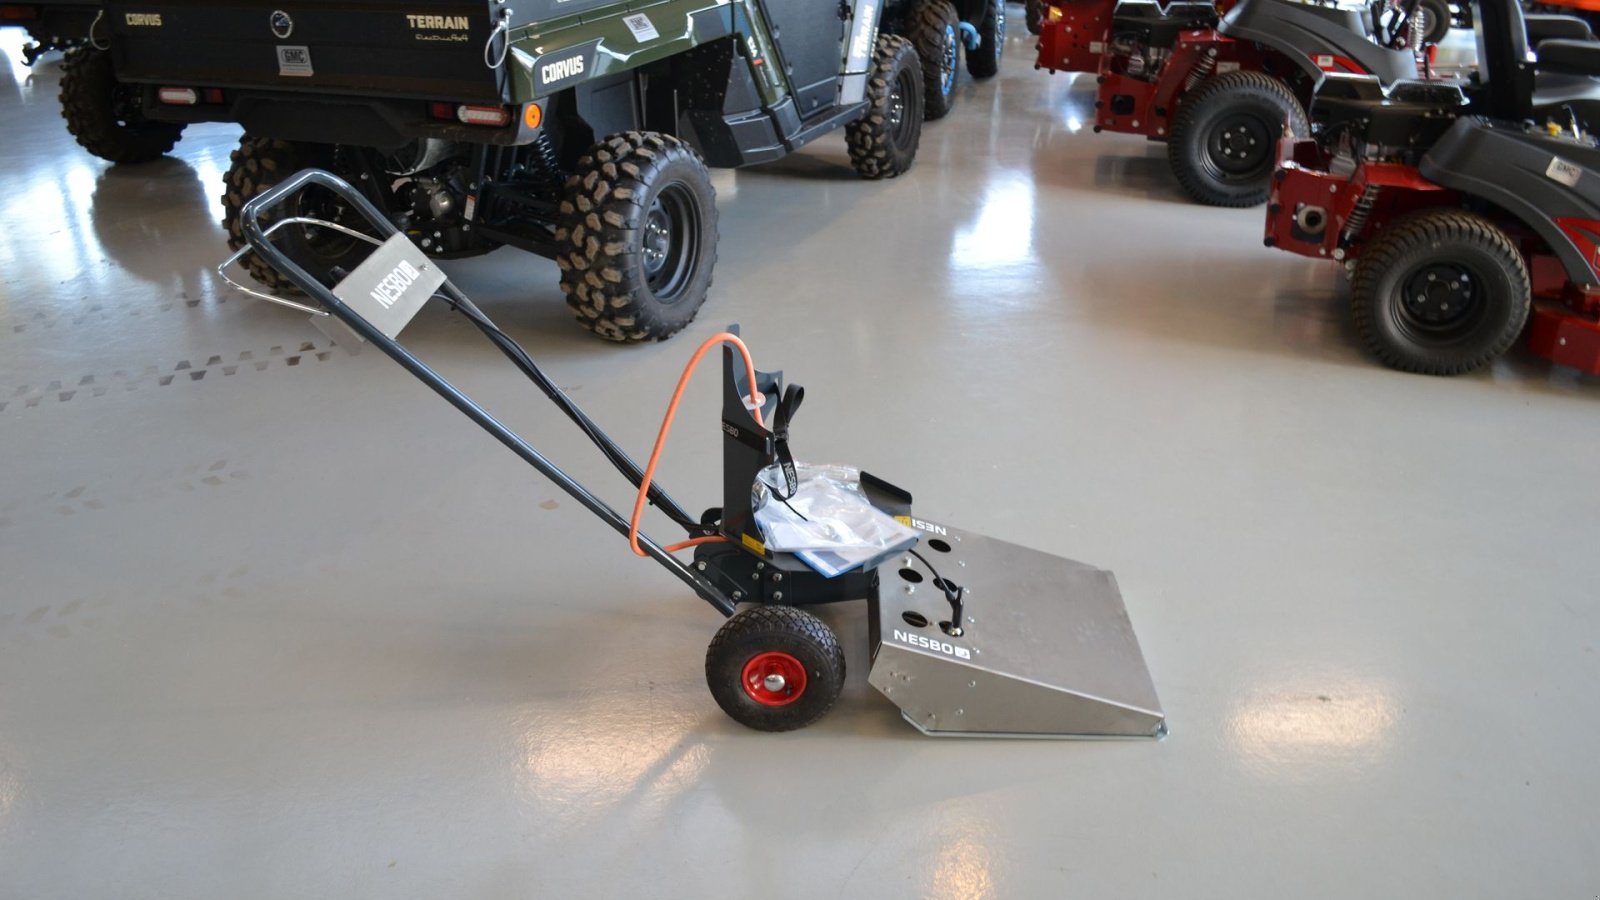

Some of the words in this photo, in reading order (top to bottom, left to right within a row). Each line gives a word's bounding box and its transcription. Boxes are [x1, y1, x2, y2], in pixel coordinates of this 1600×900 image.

[125, 13, 162, 26] CORVUS
[406, 14, 470, 30] TERRAIN
[541, 54, 584, 85] CORVUS
[370, 267, 413, 310] NESBO
[721, 422, 739, 438] ESBO
[893, 628, 954, 655] NESBO
